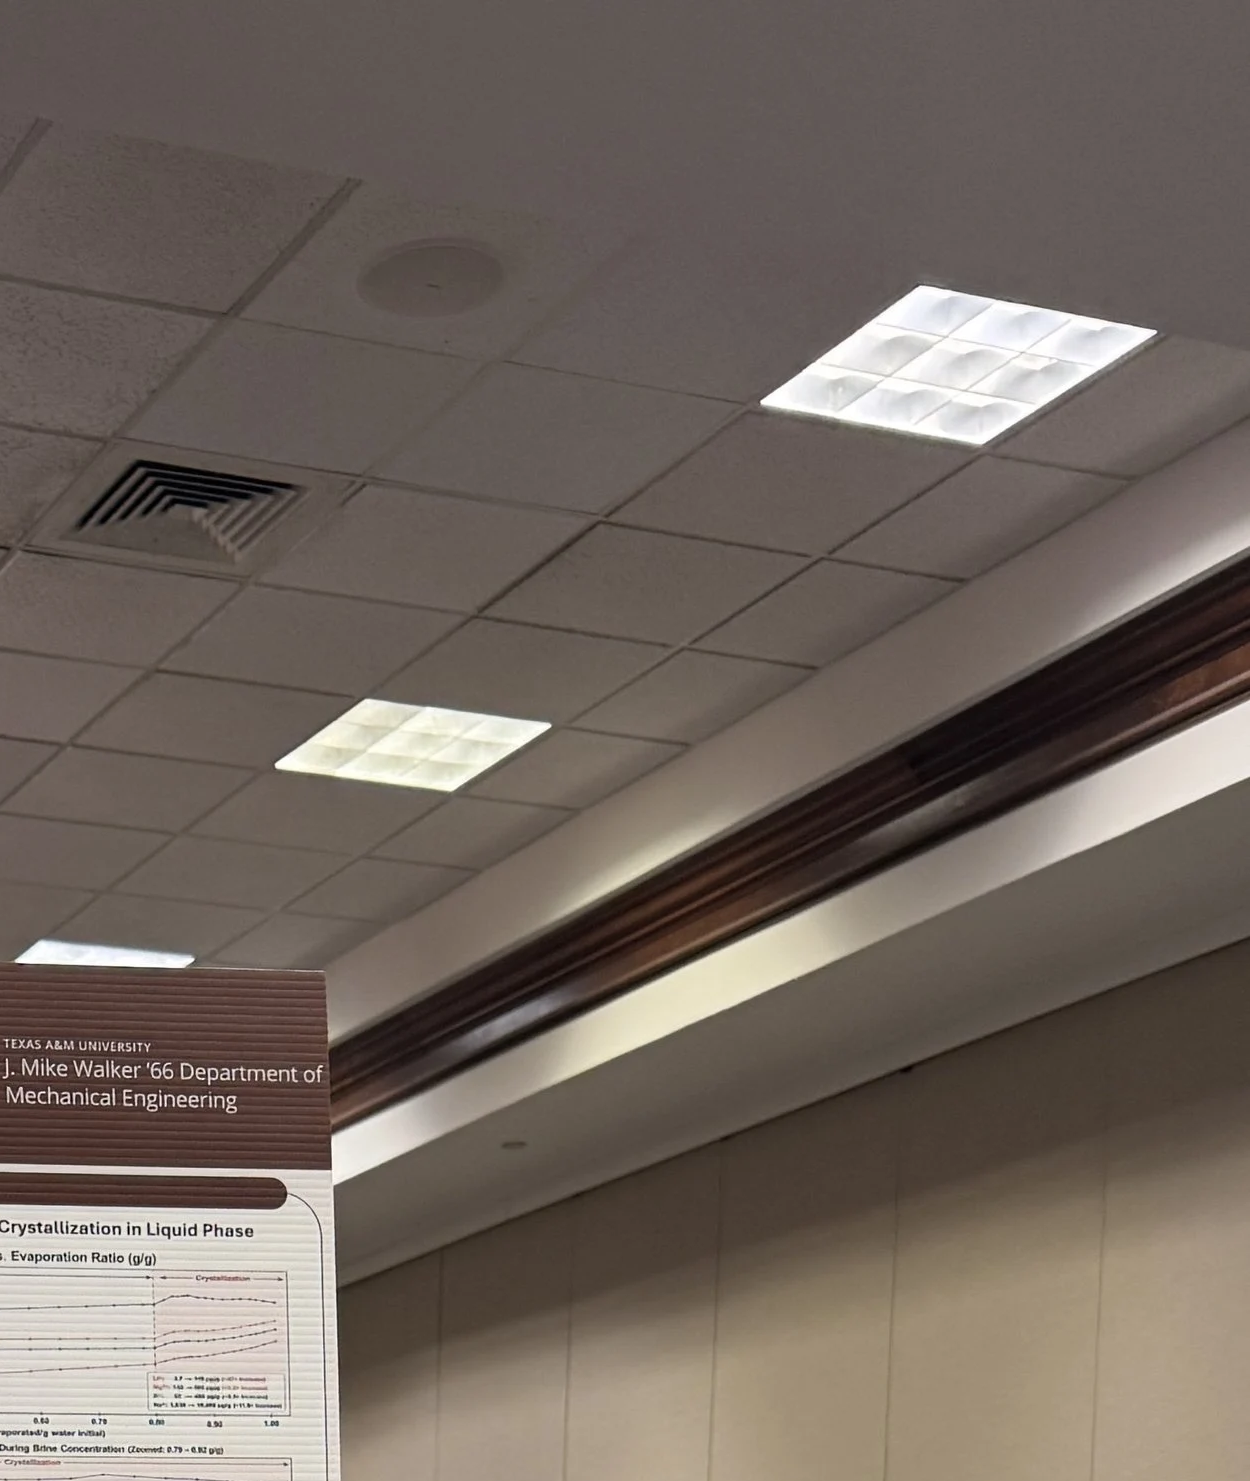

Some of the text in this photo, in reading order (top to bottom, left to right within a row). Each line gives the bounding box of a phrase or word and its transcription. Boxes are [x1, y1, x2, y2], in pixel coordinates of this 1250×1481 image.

[3, 1038, 151, 1053] TEXAS A&M UNIVERSITY
[2, 1058, 15, 1080] J.
[21, 1058, 68, 1077] Mike
[72, 1059, 142, 1079] Walker
[180, 1062, 299, 1086] Department
[303, 1064, 324, 1084] of
[6, 1086, 238, 1114] Mechanical Engineering
[126, 1221, 142, 1236] in
[146, 1222, 198, 1240] Liquid
[203, 1223, 254, 1238] Phase
